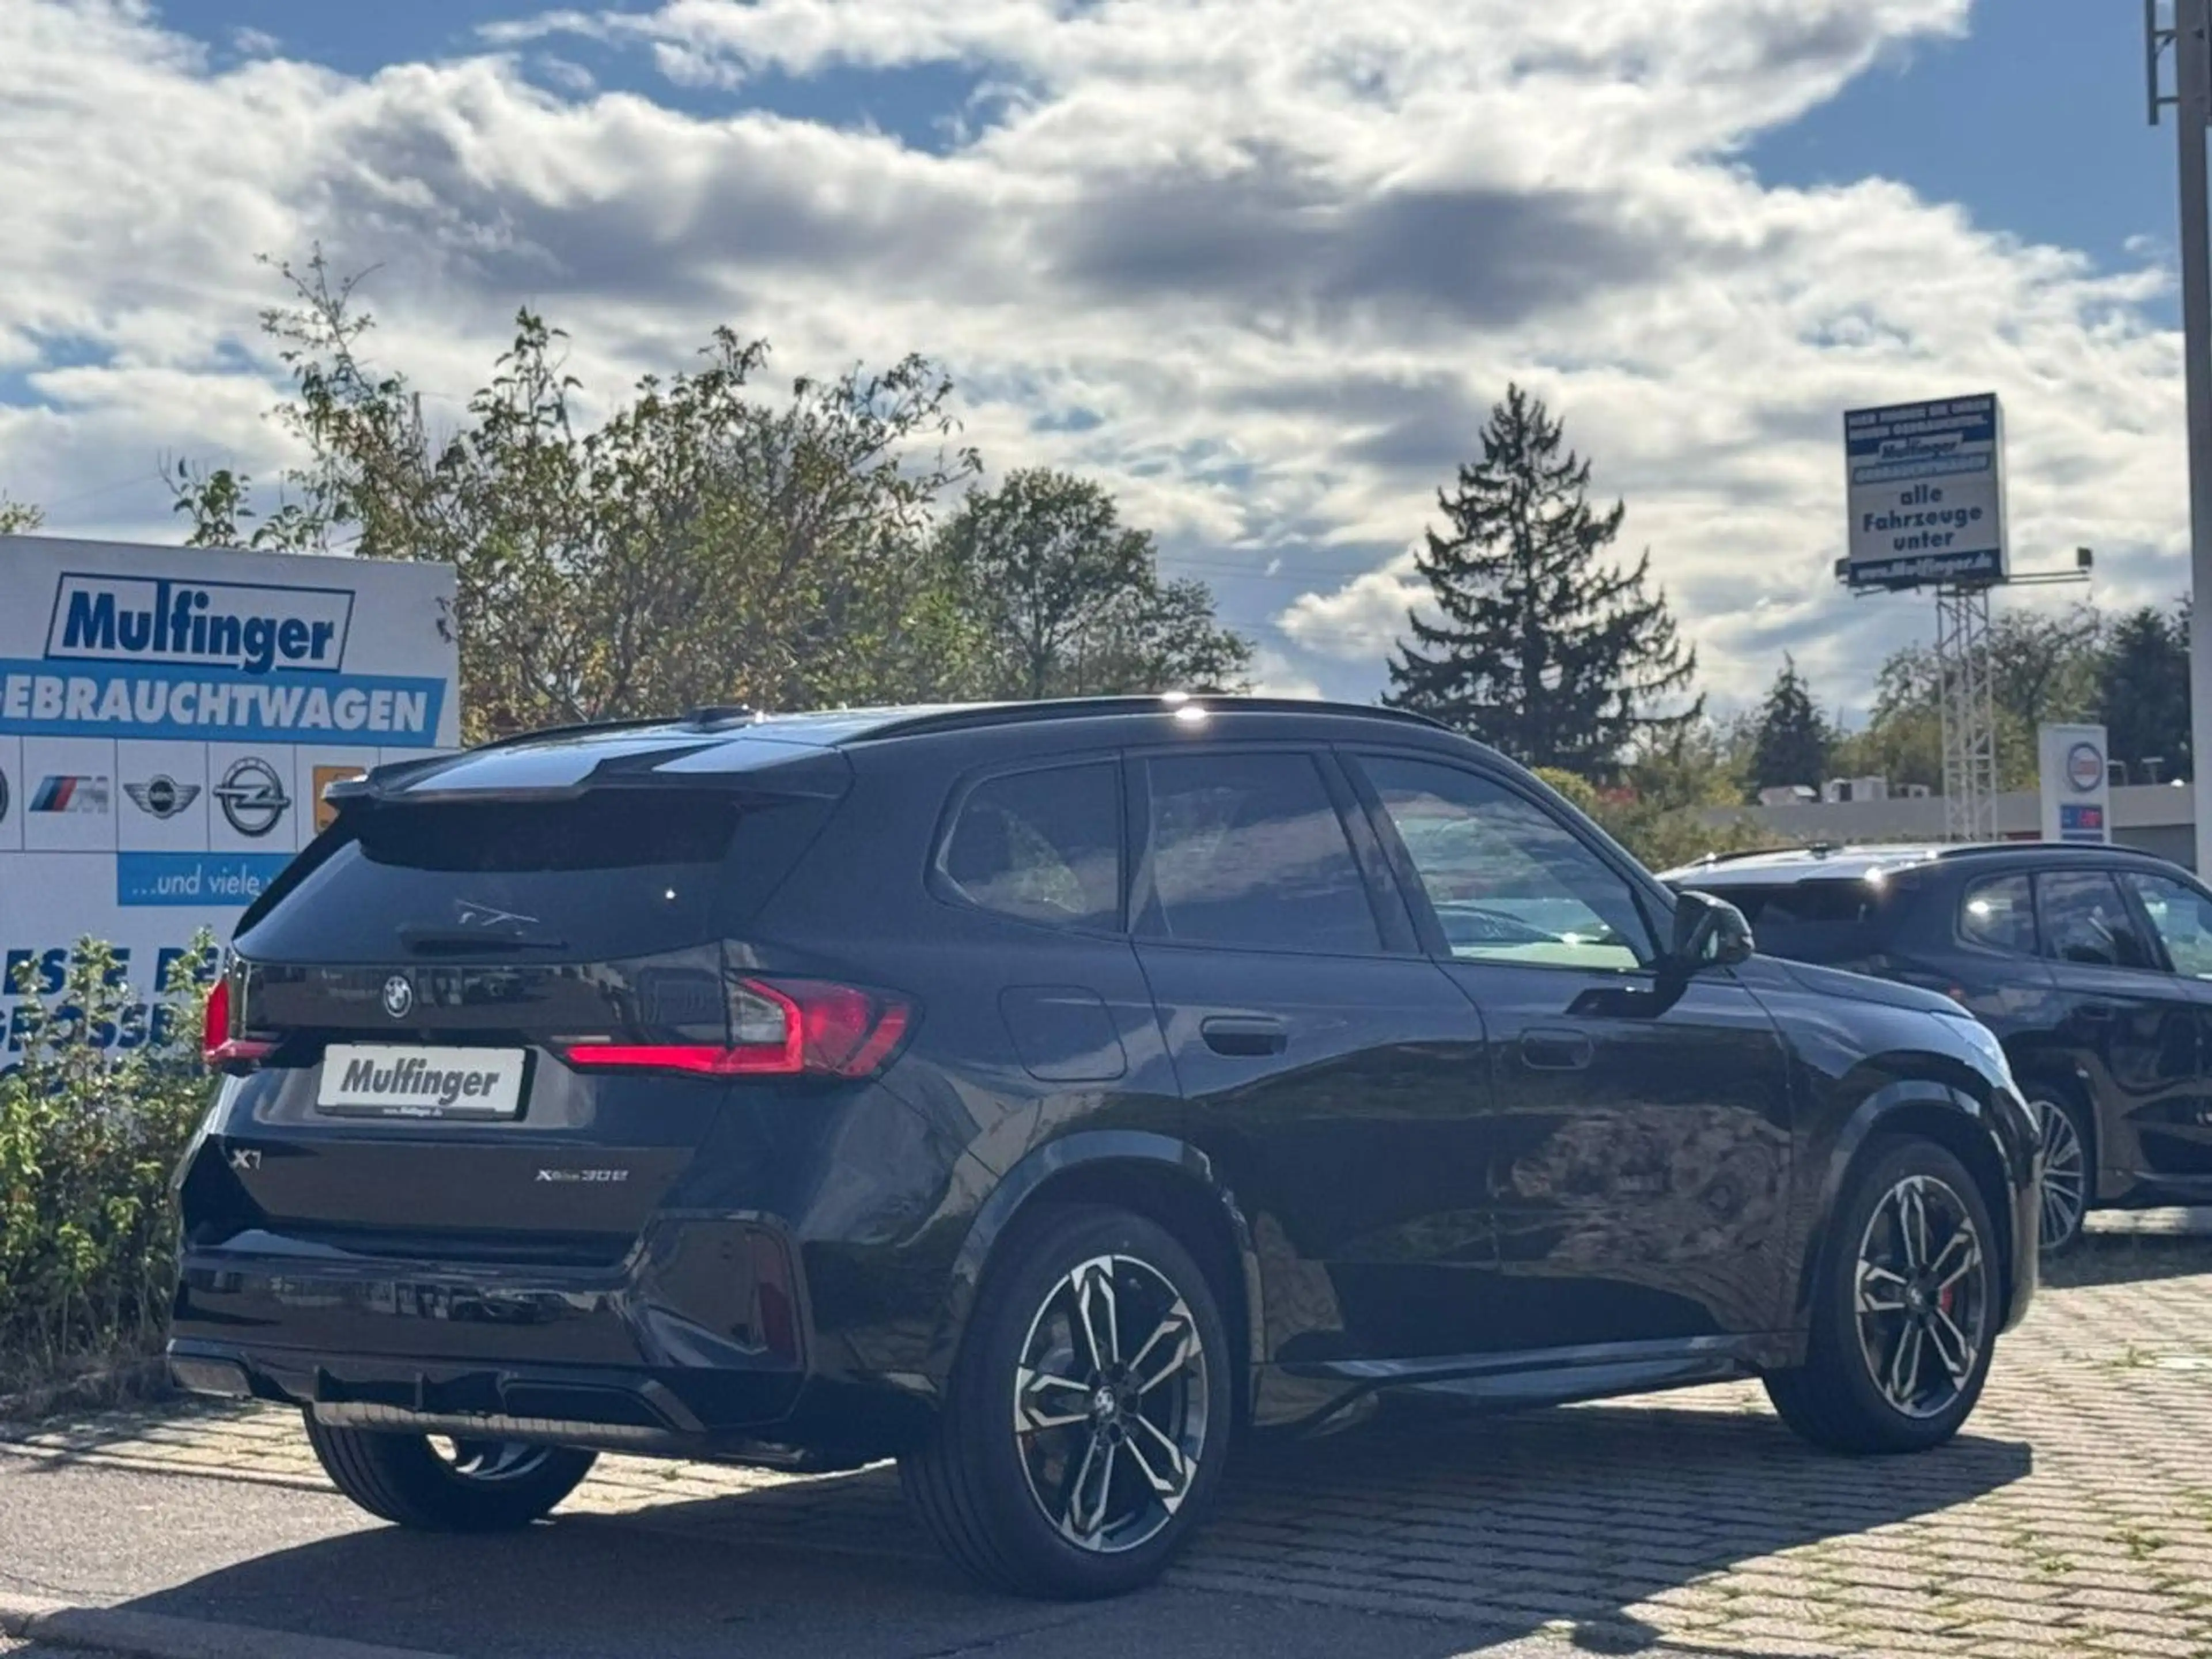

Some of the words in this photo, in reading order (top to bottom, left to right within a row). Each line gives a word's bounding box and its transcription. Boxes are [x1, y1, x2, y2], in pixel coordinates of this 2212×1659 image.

[1900, 484, 1943, 506] alle
[1862, 506, 1983, 533] Fahrzeuge
[1893, 531, 1956, 551] unter
[62, 581, 334, 674] Mulfinger
[0, 673, 428, 732] EBRAUCHTWAGEN
[208, 863, 260, 896] viele
[340, 1058, 499, 1106] Mulfinger
